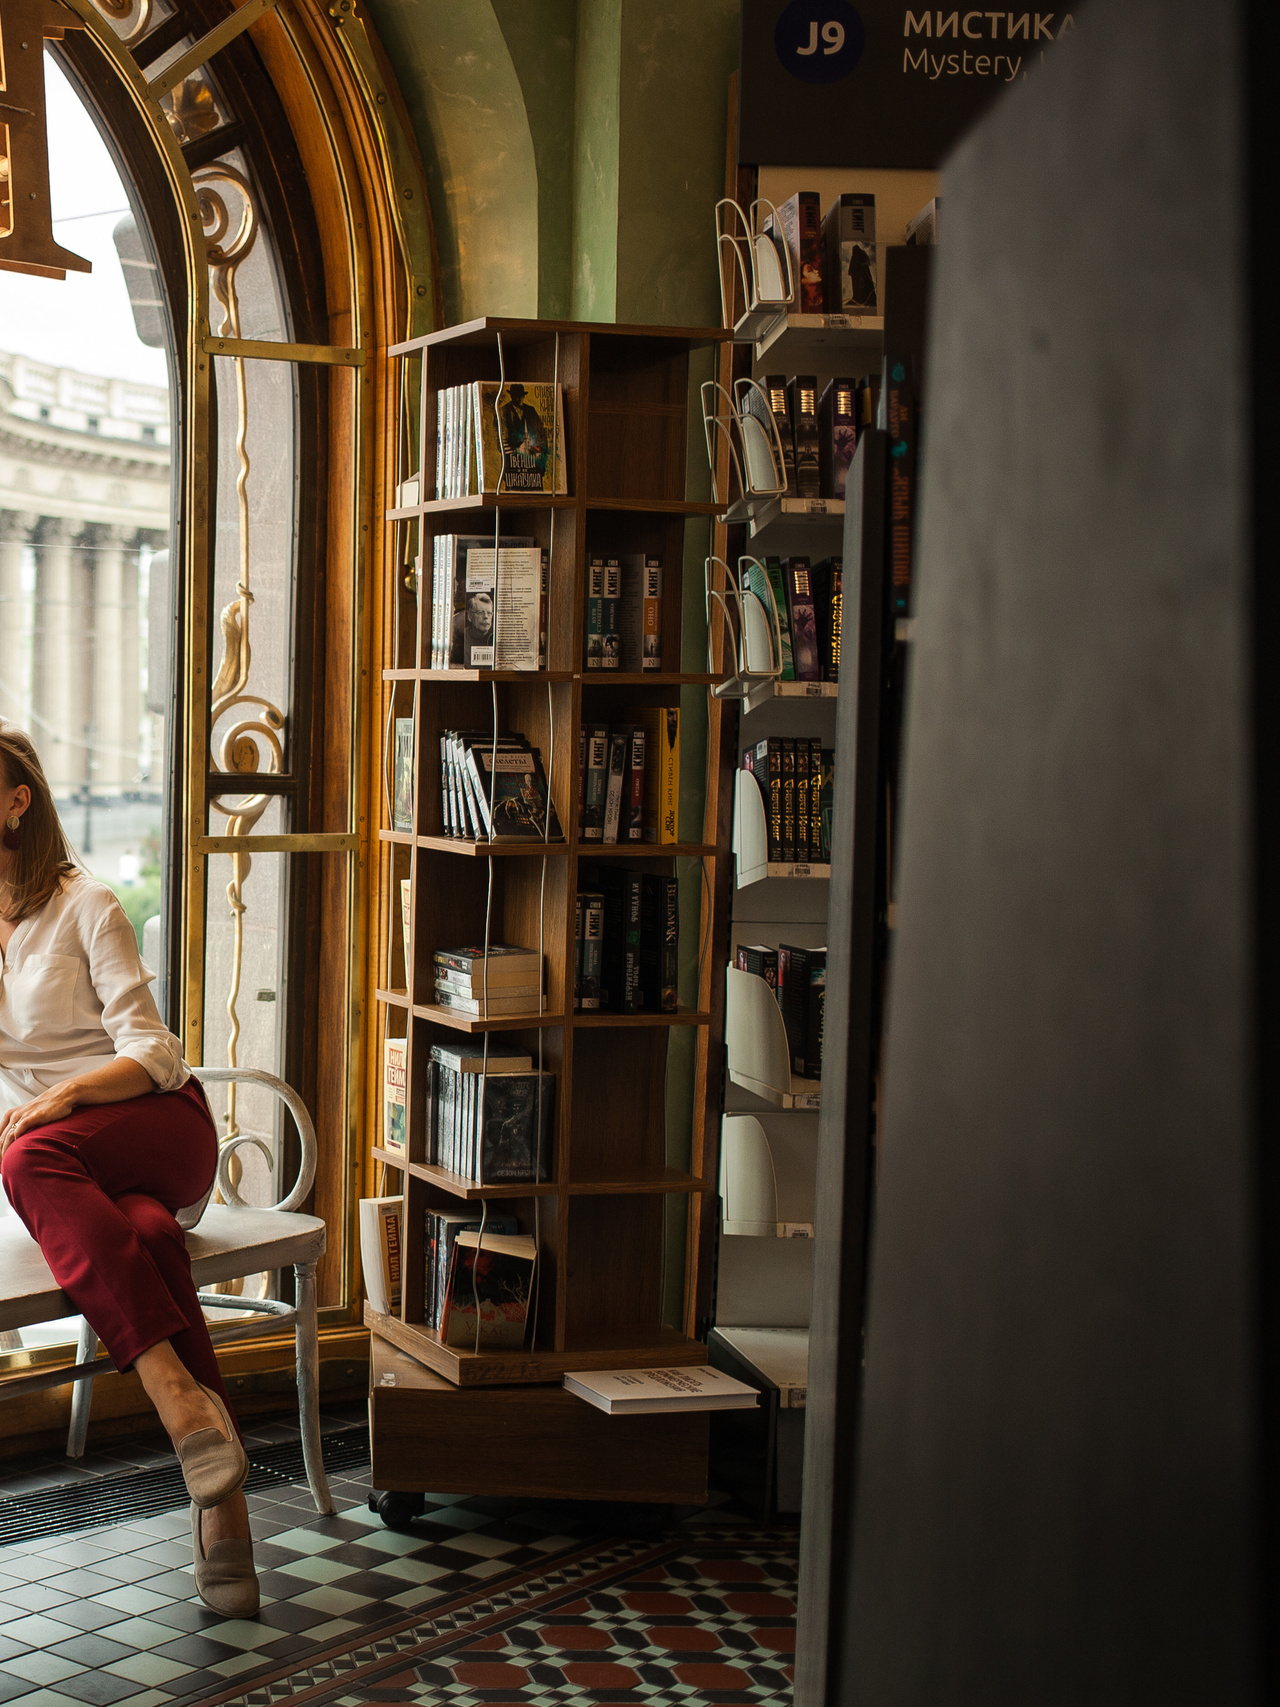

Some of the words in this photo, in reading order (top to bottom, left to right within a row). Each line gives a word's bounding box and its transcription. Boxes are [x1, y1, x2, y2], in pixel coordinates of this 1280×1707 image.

[795, 20, 846, 56] J9
[851, 208, 865, 234] КИНГ
[770, 389, 786, 415] КИНГ
[800, 390, 815, 416] КИНГ
[837, 391, 852, 416] КИНГ
[510, 453, 536, 468] ГВЕНДИ
[505, 473, 542, 488] ШКАТУЛКА
[592, 569, 602, 594] КИНГ
[608, 570, 618, 594] КИНГ
[648, 570, 658, 596] КИНГ
[794, 570, 810, 596] КИНГ
[593, 740, 604, 766] КИНГ
[632, 741, 644, 766] КИНГ
[632, 882, 640, 894] ЛИ
[589, 912, 600, 937] КИНГ
[666, 883, 676, 942] ВЕДЬМАК
[626, 952, 634, 1000] НЕФРИТОВЫЙ
[390, 1254, 400, 1280] НИЛ
